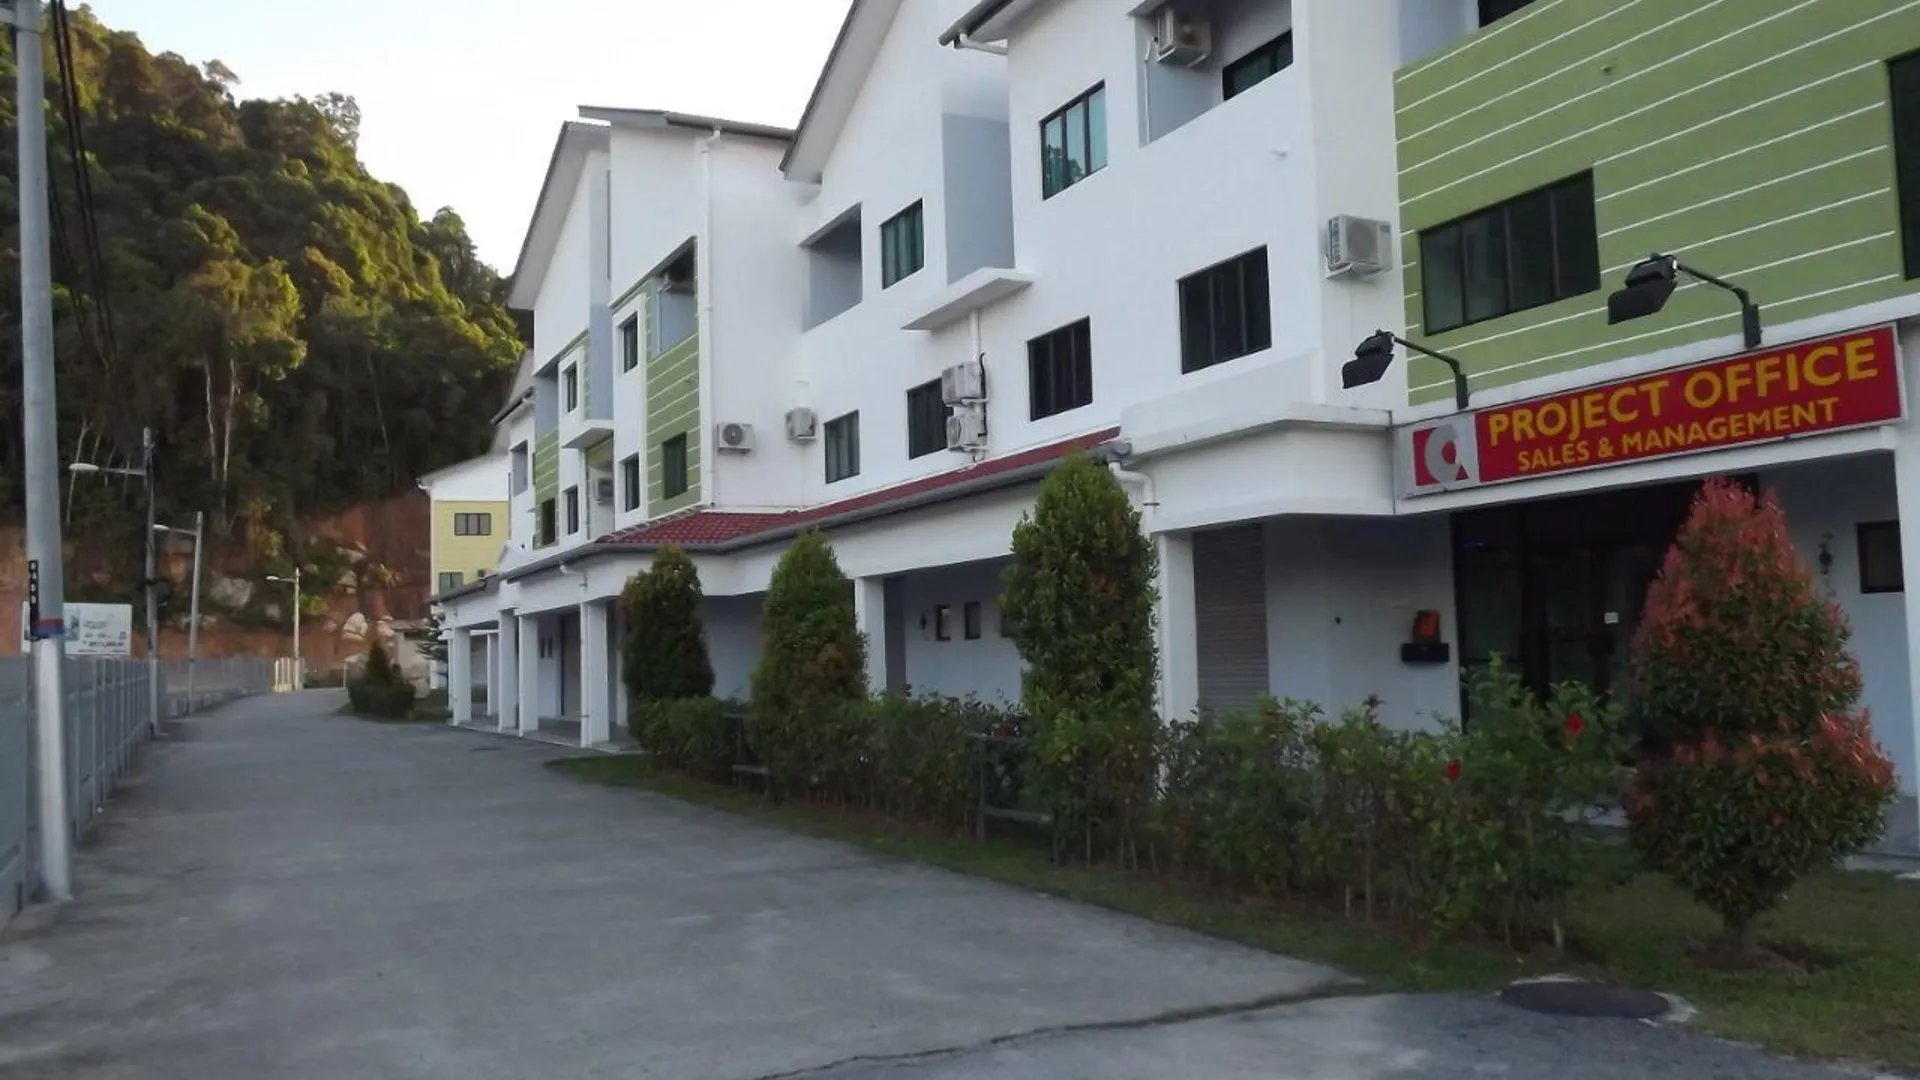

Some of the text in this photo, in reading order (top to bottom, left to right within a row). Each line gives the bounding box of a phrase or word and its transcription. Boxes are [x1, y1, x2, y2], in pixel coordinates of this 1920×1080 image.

[1489, 338, 1878, 447] PROJECT OFFICE
[1518, 397, 1839, 472] SALES & MANAGEMENT
